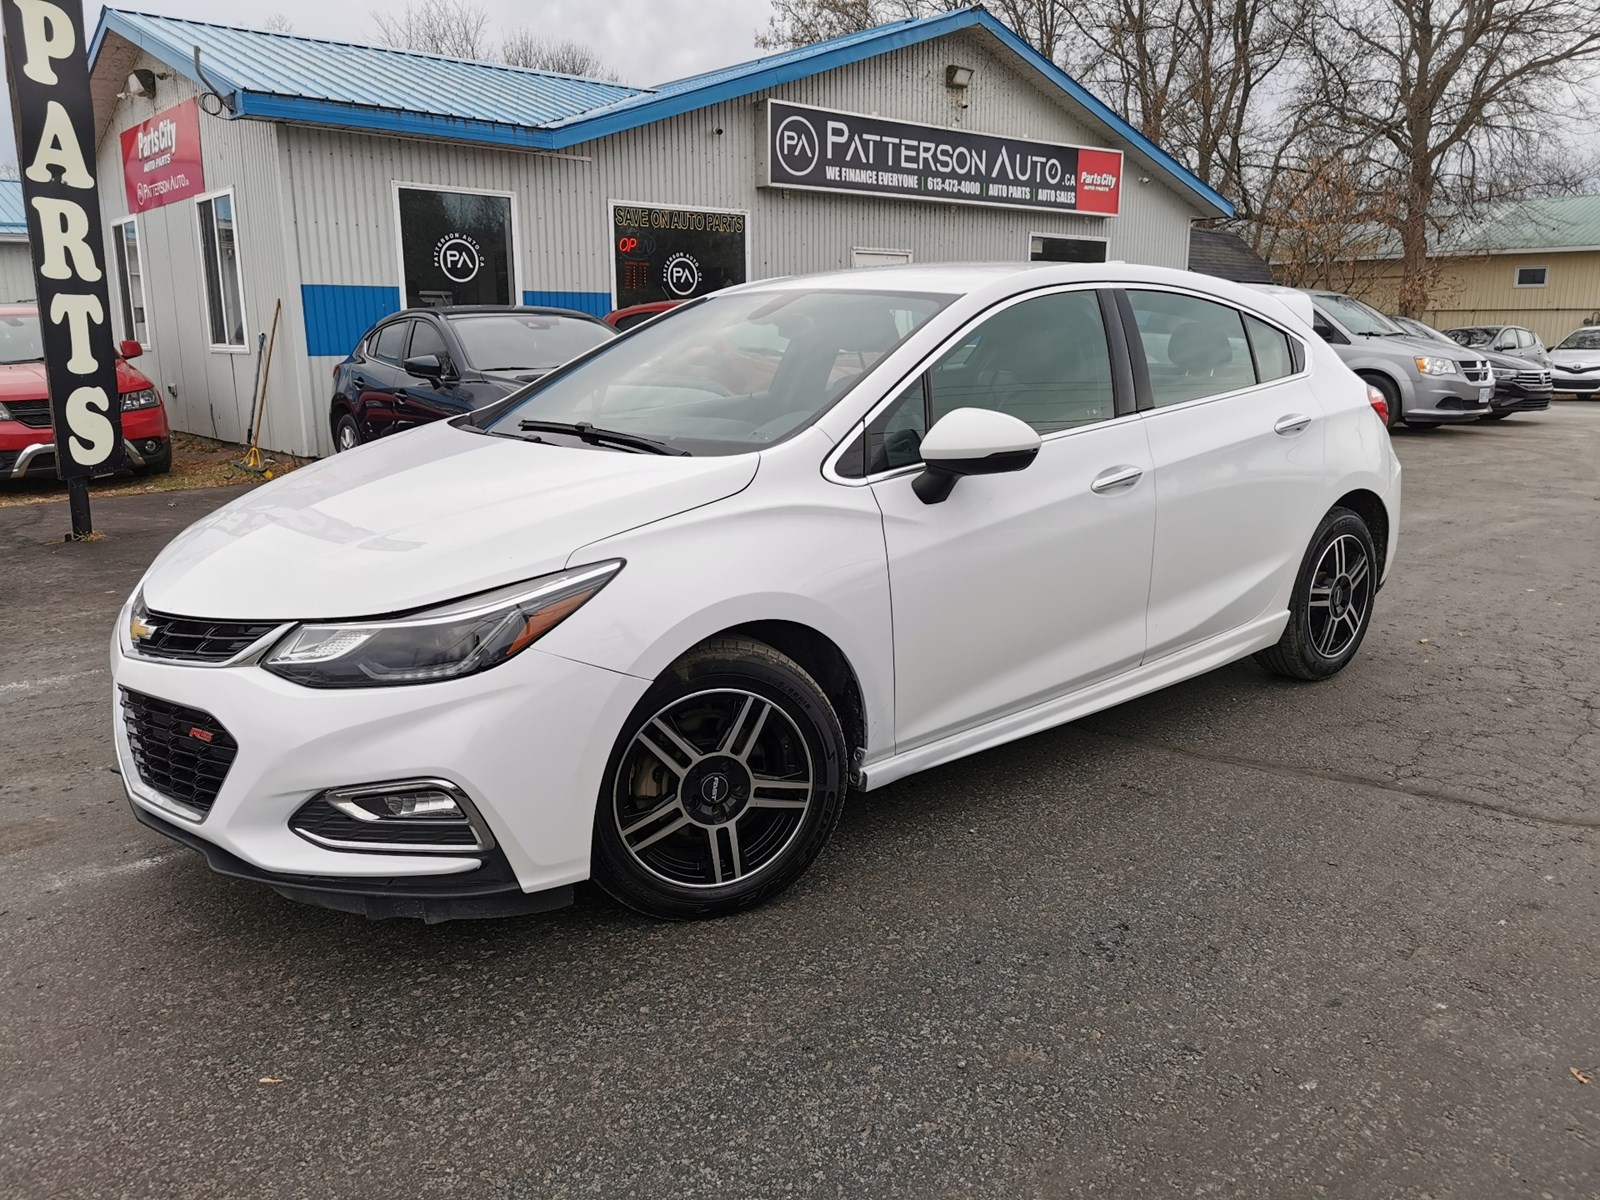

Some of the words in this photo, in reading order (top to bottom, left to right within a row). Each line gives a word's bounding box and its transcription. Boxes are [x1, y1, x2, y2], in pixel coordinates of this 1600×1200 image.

[783, 130, 813, 158] PA
[826, 120, 987, 176] PATTERSON
[143, 178, 170, 200] PATTERSON
[825, 165, 841, 181] WE
[841, 167, 877, 185] FINANCE
[878, 171, 918, 189] EVERYONE
[927, 176, 981, 195] 613-473-4000
[988, 183, 1007, 198] AUTO
[1008, 185, 1031, 200] PARTS
[1037, 188, 1056, 202] AUTO
[1056, 190, 1076, 204] SALES
[13, 0, 115, 466] PARTS
[615, 207, 649, 227] SAVE
[651, 209, 670, 229] ON
[670, 211, 705, 231] AUTO
[706, 213, 744, 233] PARTS
[433, 232, 460, 267] PATTERSON
[446, 250, 474, 268] PA
[672, 267, 694, 283] PA
